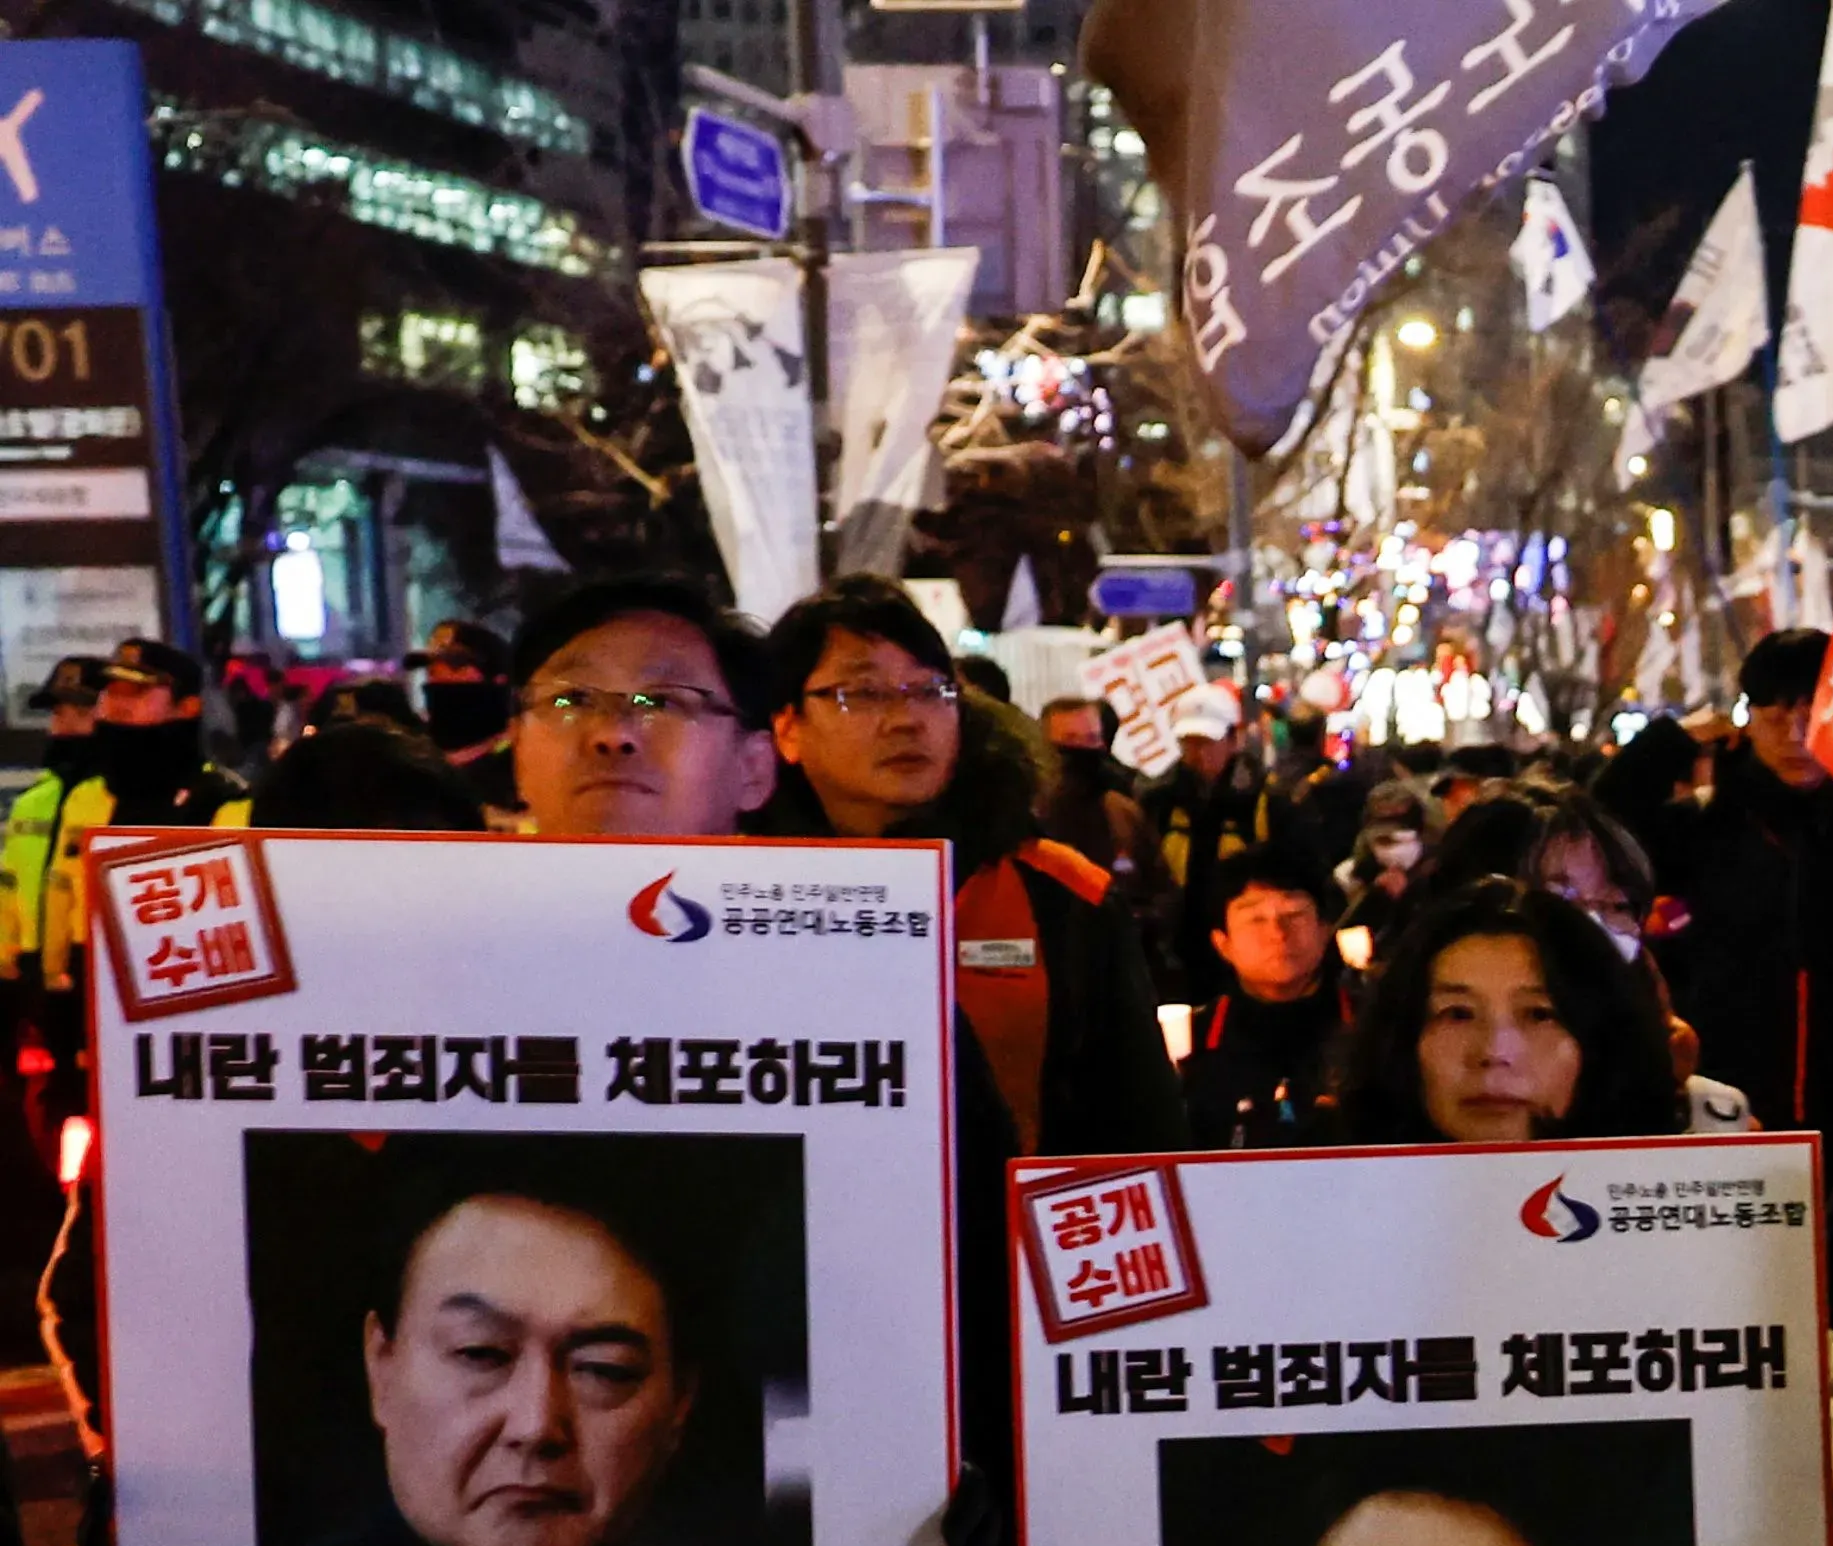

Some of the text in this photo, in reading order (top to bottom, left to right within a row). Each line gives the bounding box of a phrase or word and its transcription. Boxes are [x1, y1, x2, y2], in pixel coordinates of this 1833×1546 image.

[0, 318, 91, 382] 01
[128, 857, 243, 925] 공개
[721, 906, 931, 937] 공공연대노동조합
[146, 920, 257, 987] 수배
[135, 1032, 906, 1108] 내란 범죄자를 체포하라!
[1049, 1181, 1157, 1250] 공개
[1608, 1200, 1807, 1234] 공공연대노동조합
[1067, 1245, 1172, 1310] 수배
[1055, 1324, 1788, 1416] 내란 범죄자를 체포하라!
